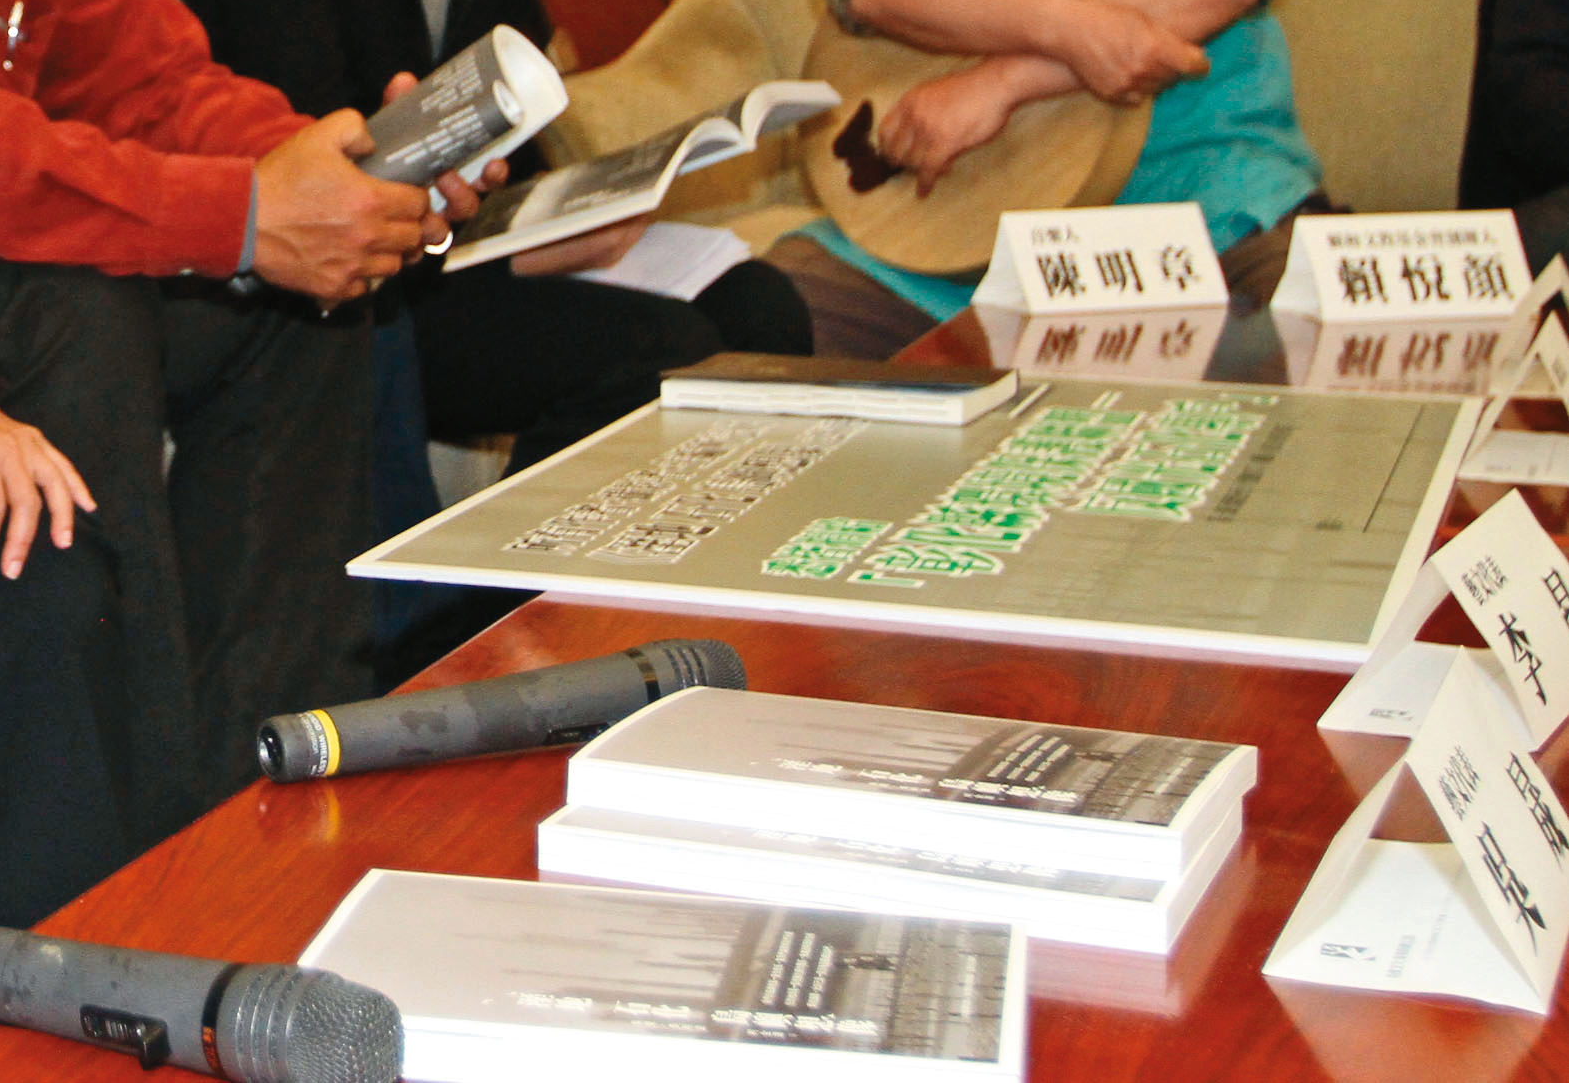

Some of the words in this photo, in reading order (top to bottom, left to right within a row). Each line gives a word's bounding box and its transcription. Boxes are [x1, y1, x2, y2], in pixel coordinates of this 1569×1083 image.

[1036, 245, 1202, 298] 陳明章
[1338, 252, 1515, 304] 賴悅顏
